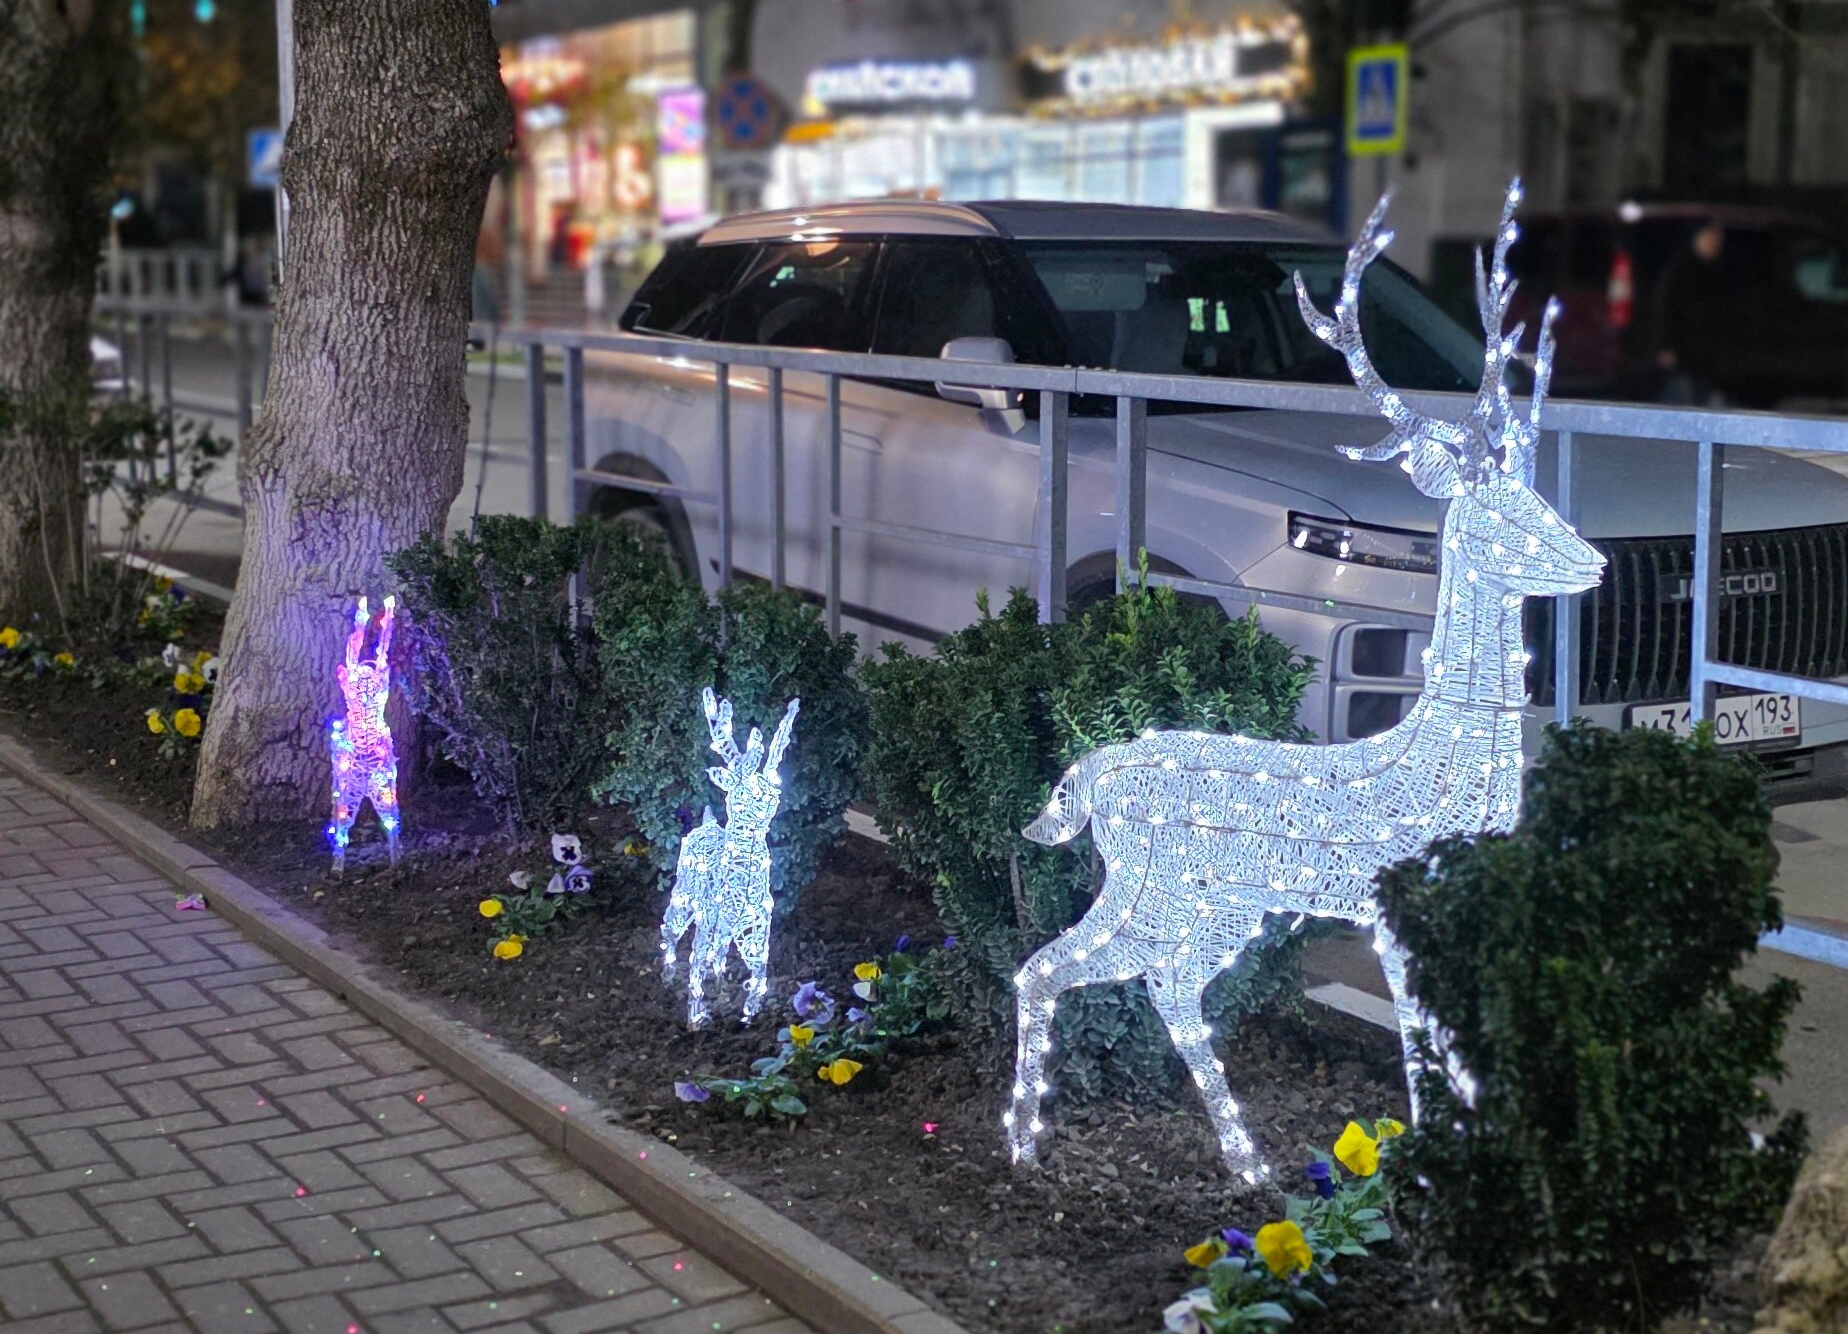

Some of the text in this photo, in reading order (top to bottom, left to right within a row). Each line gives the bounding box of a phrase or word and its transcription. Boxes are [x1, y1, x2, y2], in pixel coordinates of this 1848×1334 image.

[1670, 572, 1776, 599] JCOO
[1755, 695, 1791, 725] 193
[1763, 724, 1782, 736] RUS
